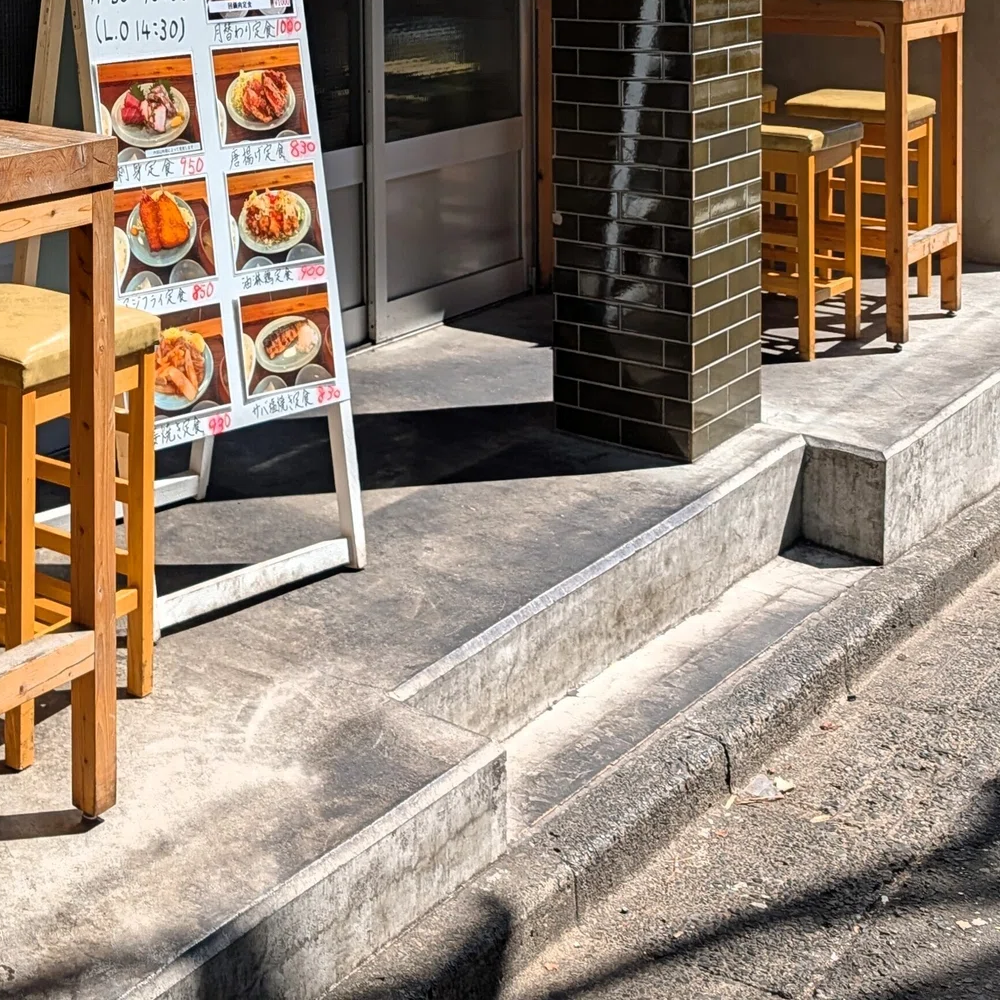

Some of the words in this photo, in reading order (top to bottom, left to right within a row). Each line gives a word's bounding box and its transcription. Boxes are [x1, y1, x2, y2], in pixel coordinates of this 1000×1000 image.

[213, 20, 275, 44] 月替わり定食
[275, 18, 302, 36] 1000
[180, 156, 204, 175] 950
[230, 143, 288, 170] 唐揚げ定食
[289, 139, 316, 158] 830
[299, 264, 325, 279] 900
[192, 281, 214, 302] 850
[252, 389, 314, 418] サバ塩焼き定食
[317, 385, 341, 404] 830
[208, 413, 231, 435] 930
